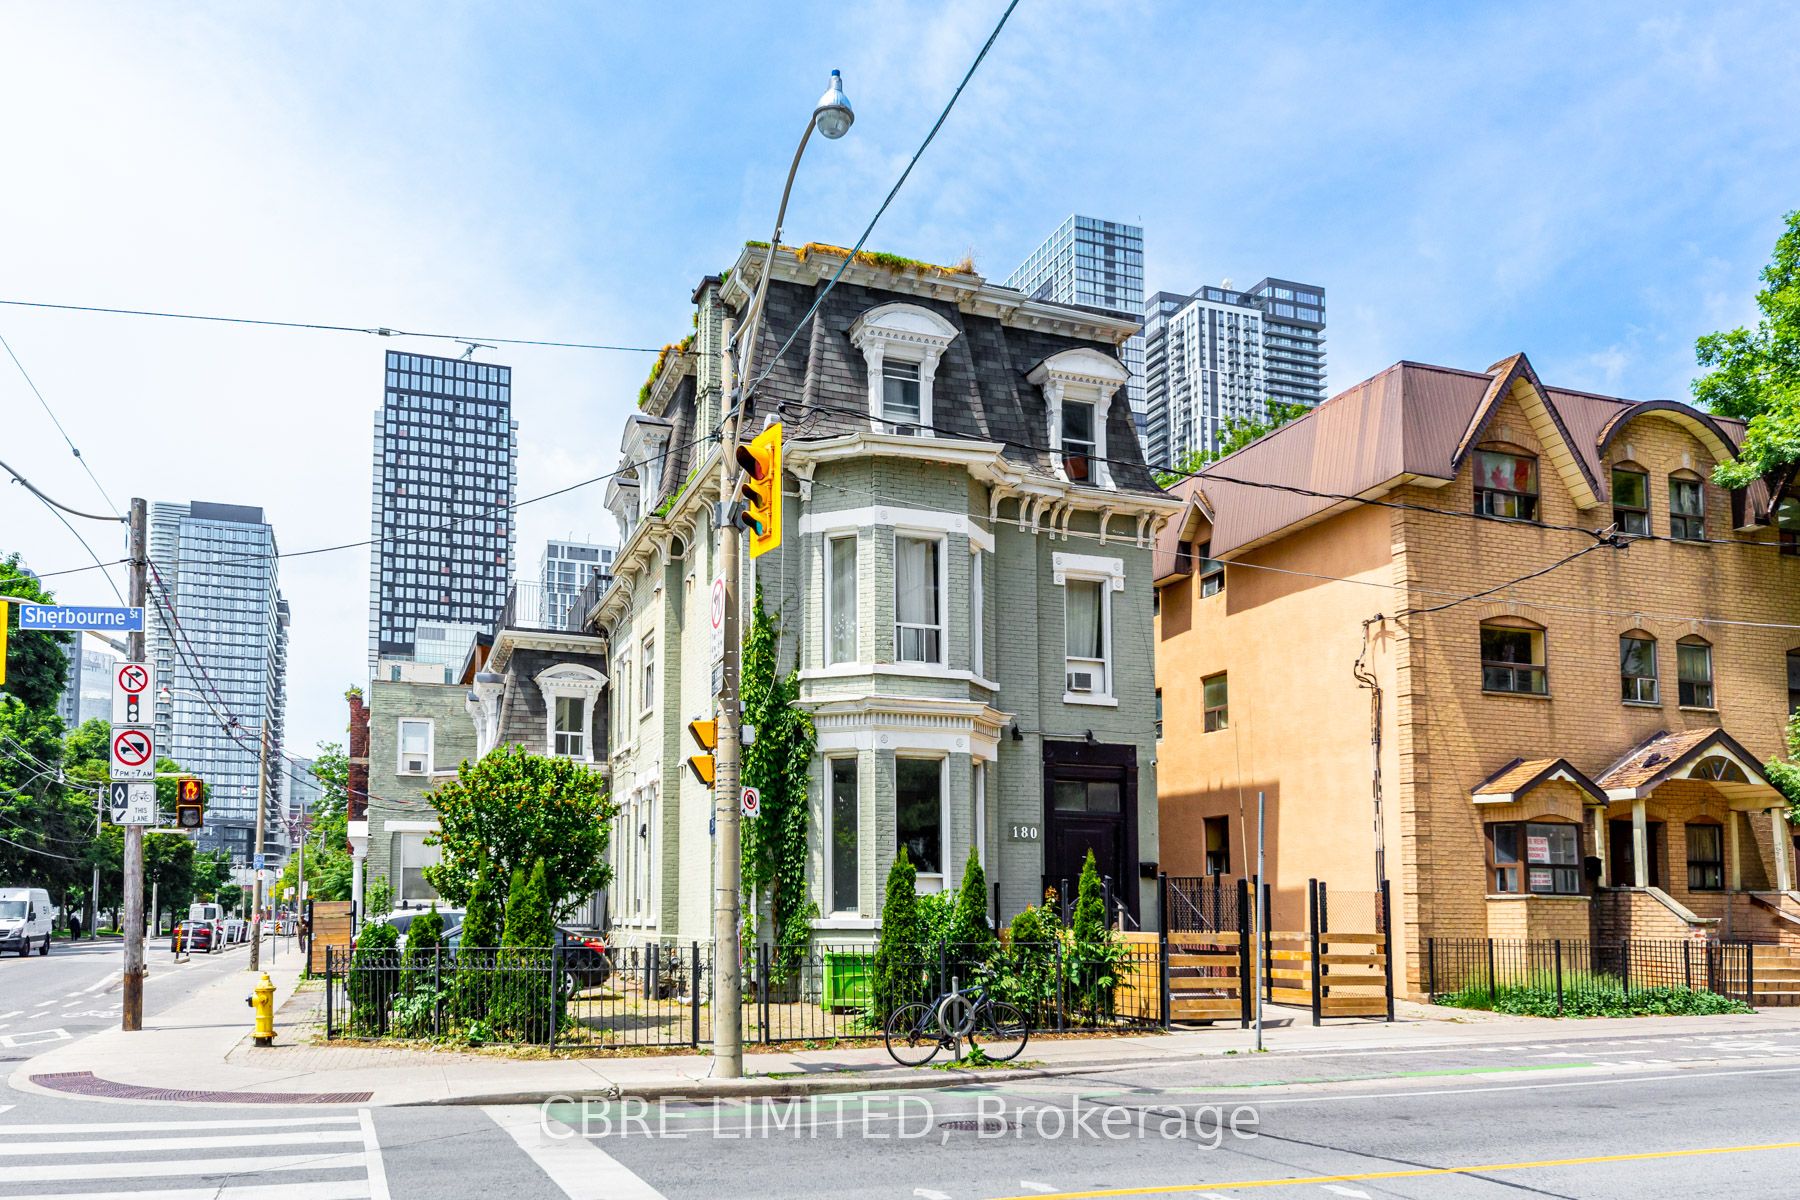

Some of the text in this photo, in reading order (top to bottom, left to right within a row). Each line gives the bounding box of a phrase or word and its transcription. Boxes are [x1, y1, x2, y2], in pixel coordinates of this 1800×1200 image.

[25, 607, 139, 625] Sherbourne St
[1013, 826, 1037, 839] 180
